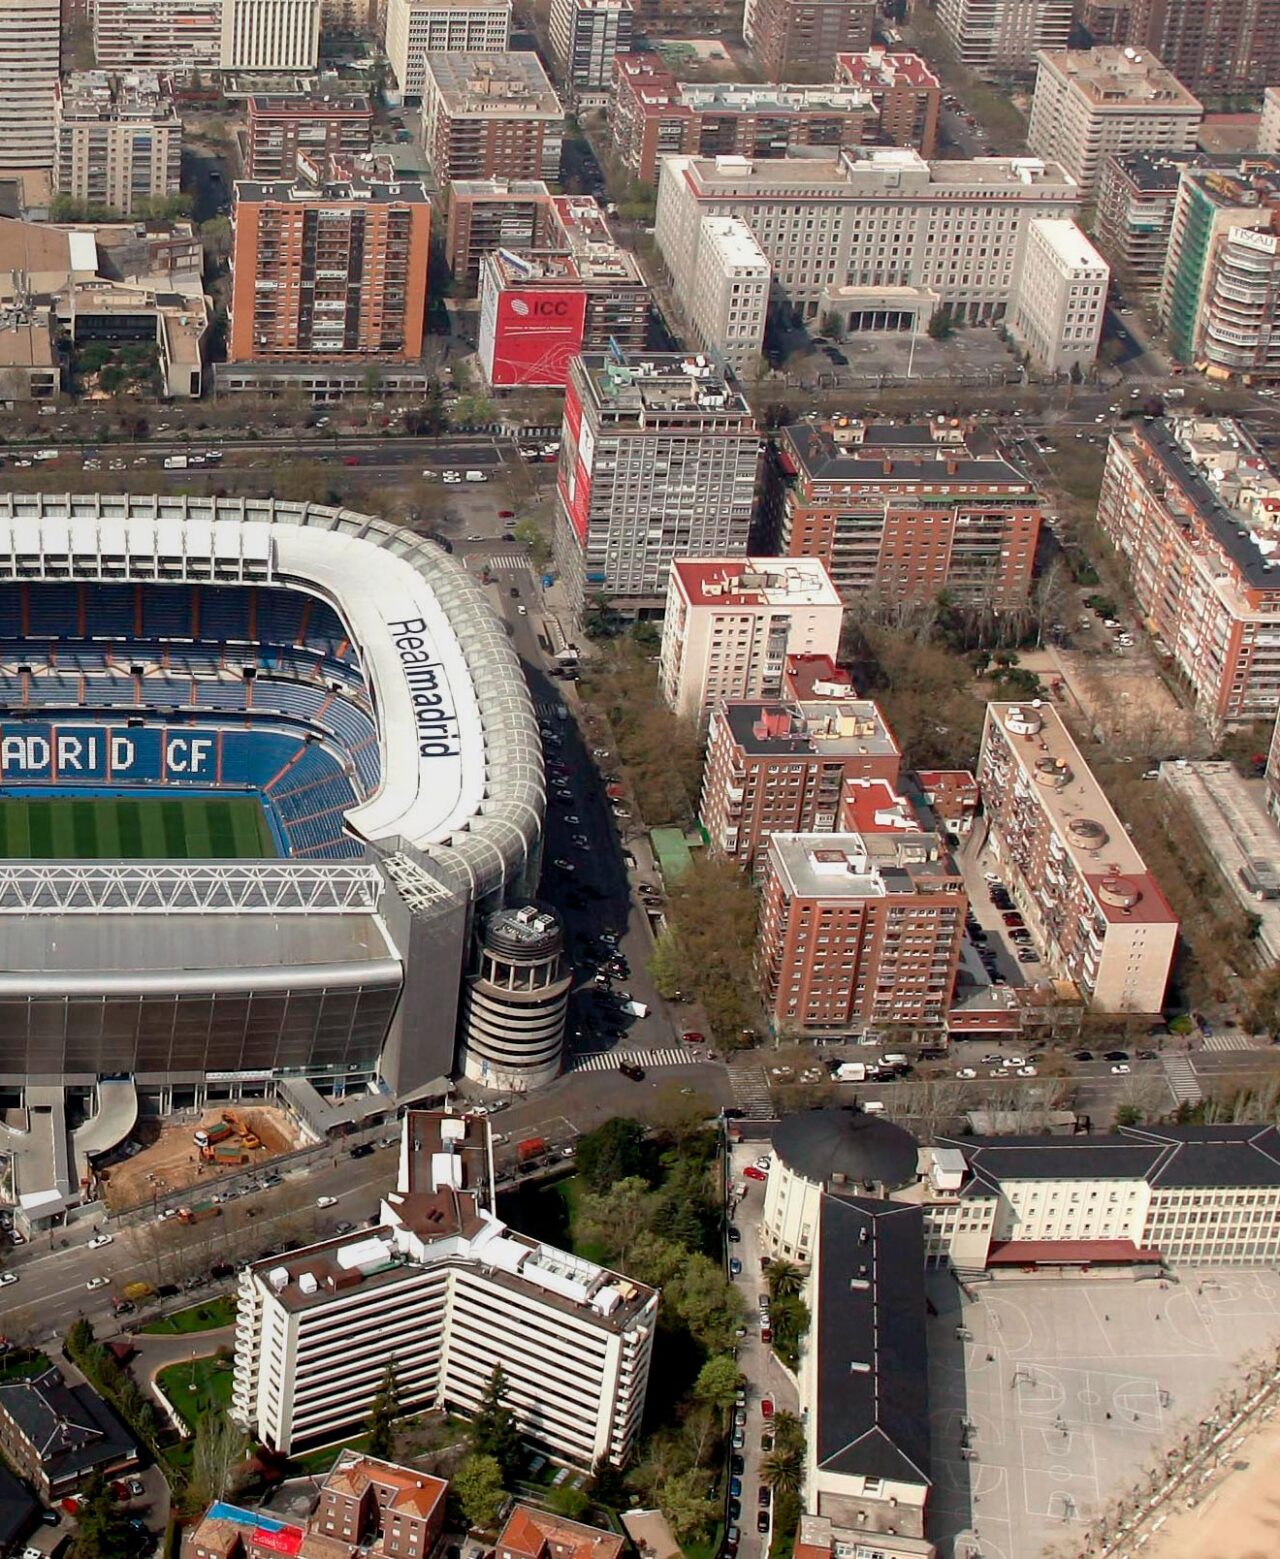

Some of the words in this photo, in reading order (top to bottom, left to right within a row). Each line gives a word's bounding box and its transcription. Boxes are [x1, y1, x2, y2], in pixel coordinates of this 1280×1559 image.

[534, 301, 568, 316] ICC
[387, 618, 460, 757] Realmadrid
[167, 738, 212, 773] C.F.
